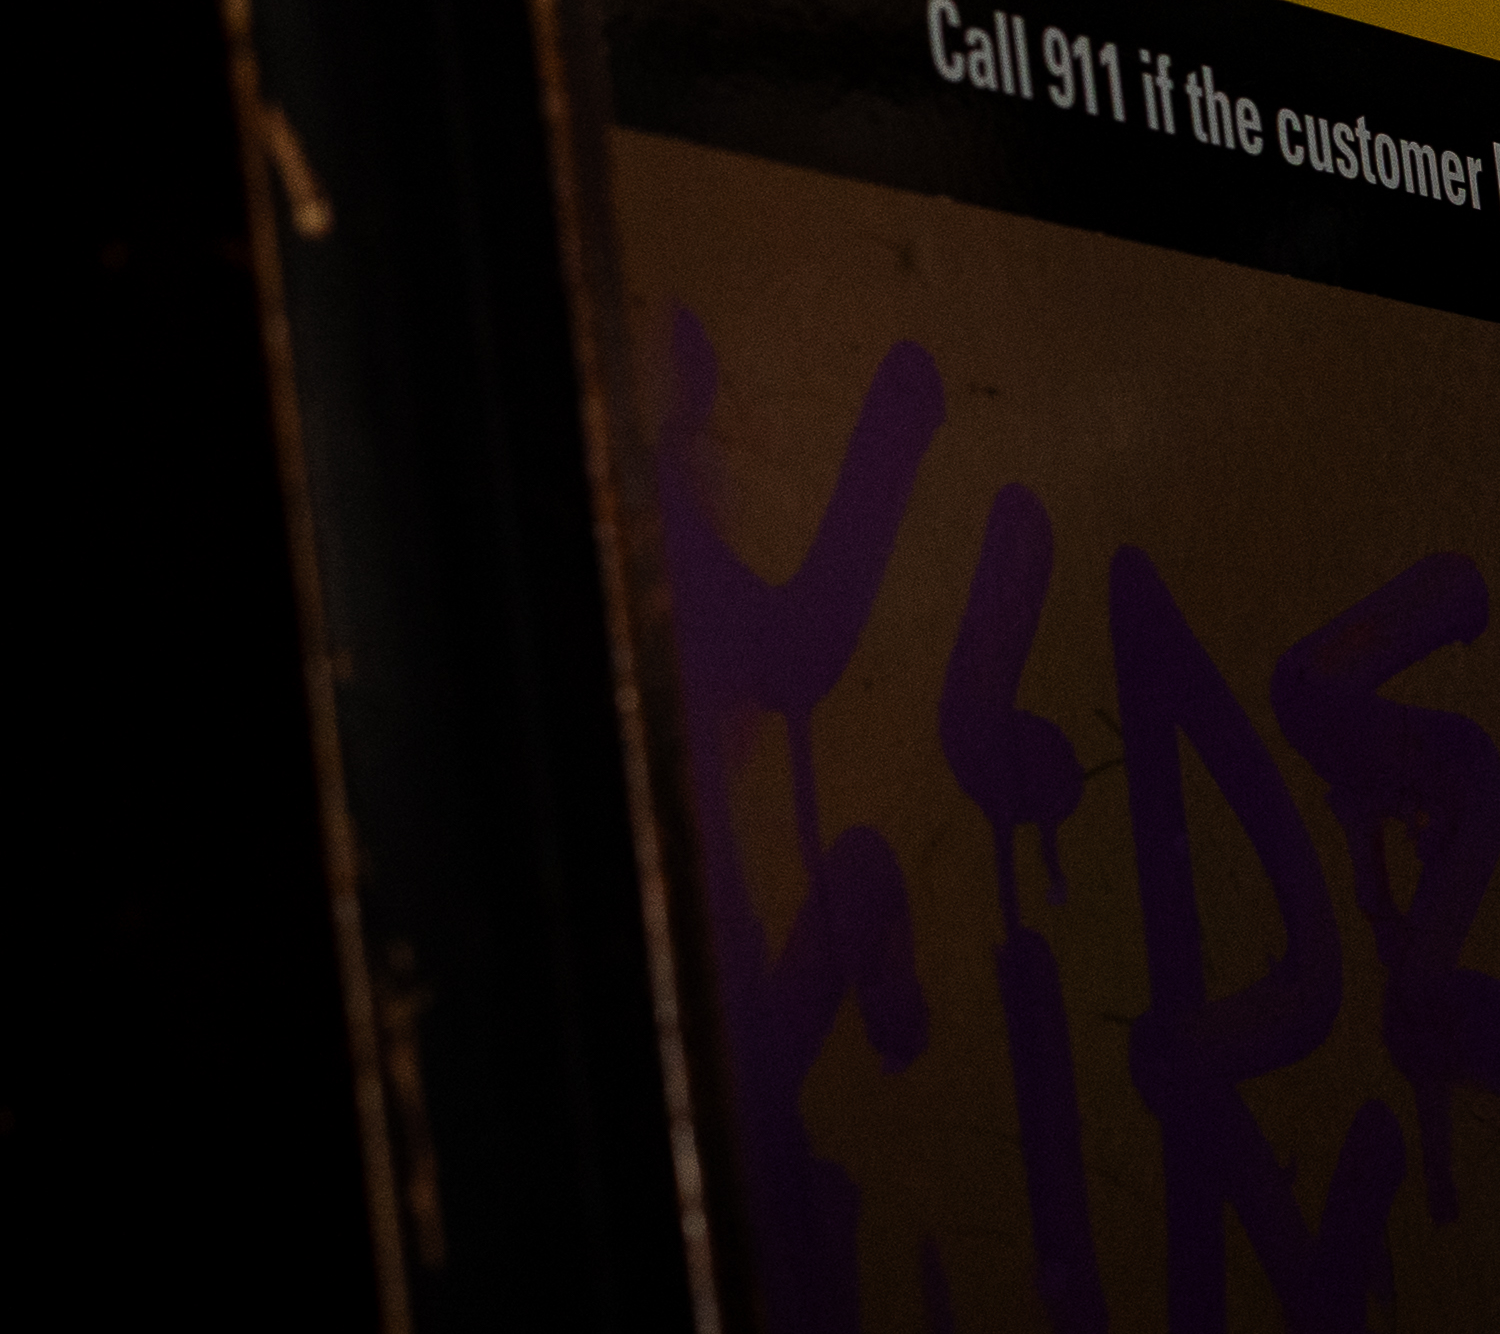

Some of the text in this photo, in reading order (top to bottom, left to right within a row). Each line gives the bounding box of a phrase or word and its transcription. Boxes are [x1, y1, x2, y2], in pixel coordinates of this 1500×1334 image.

[1045, 26, 1125, 123] 911
[1140, 49, 1177, 135] if
[1186, 65, 1263, 156] the
[1277, 105, 1482, 211] customer
